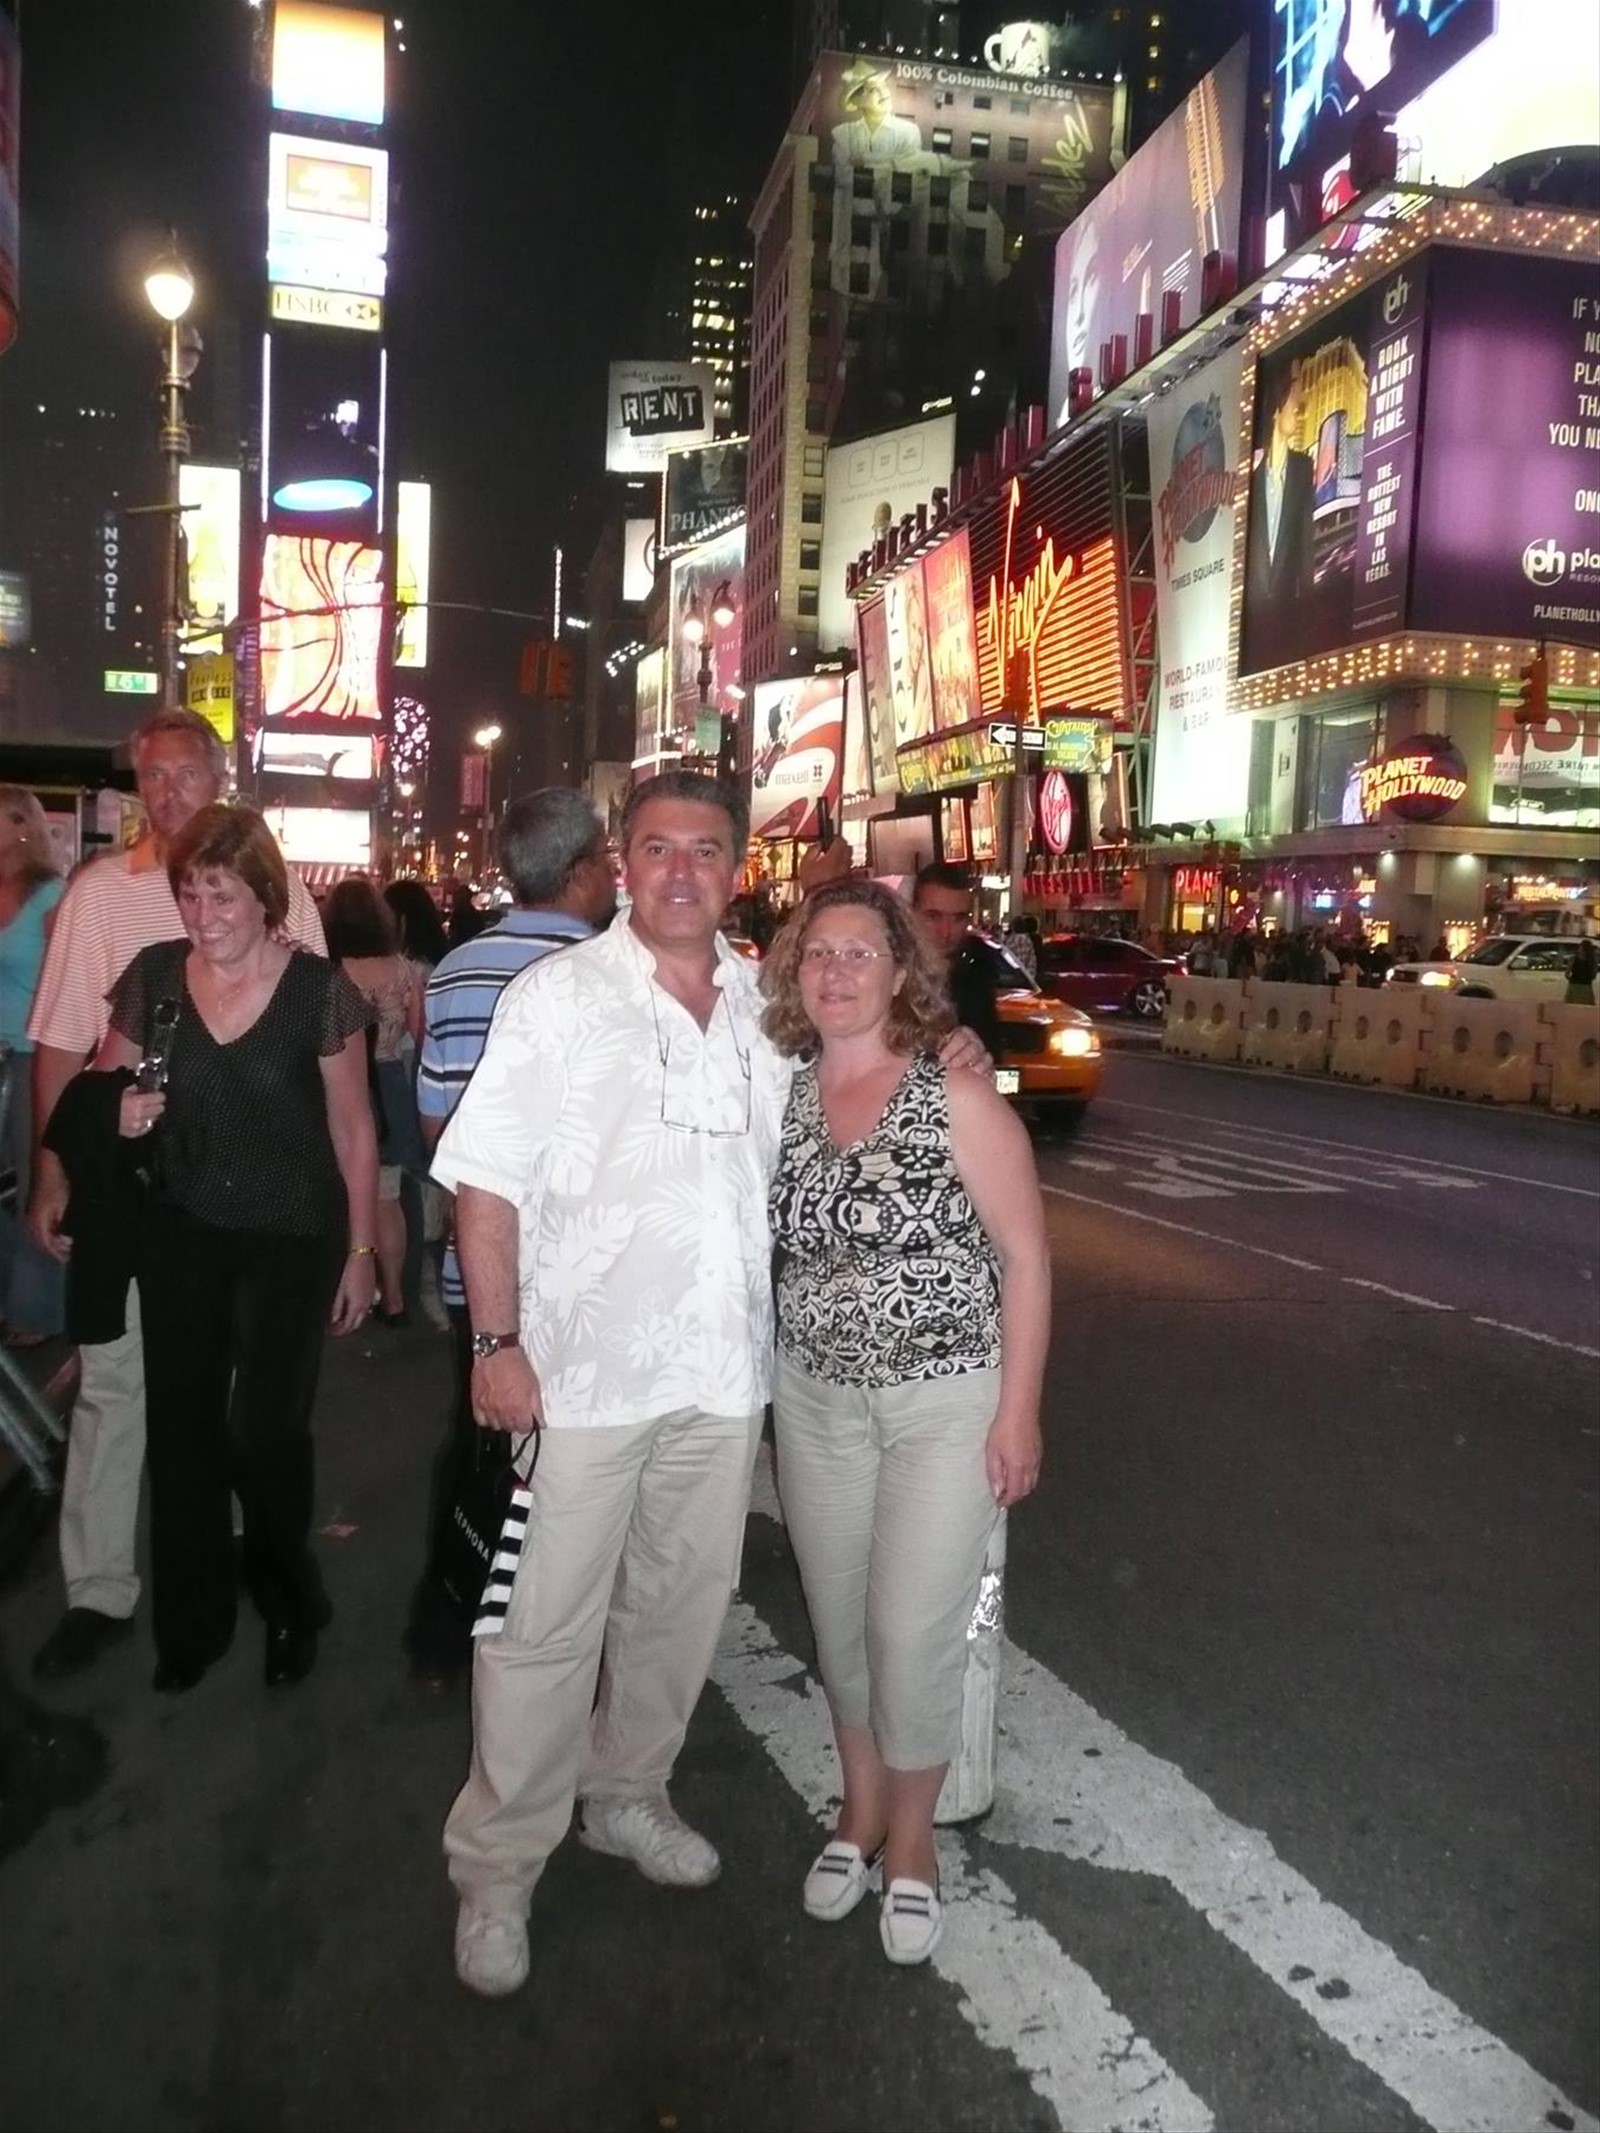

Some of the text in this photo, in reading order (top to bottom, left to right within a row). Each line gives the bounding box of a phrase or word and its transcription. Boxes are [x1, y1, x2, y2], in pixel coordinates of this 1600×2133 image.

[896, 64, 1073, 100] 100% Colombian Coffee
[276, 291, 332, 314] HSBC
[1573, 298, 1588, 319] IF
[1378, 335, 1409, 370] BOOK
[1370, 353, 1415, 397] A NIGHT
[623, 391, 698, 422] RENT
[1376, 384, 1404, 416] WITH
[1372, 406, 1406, 440] FAME.
[1549, 423, 1580, 447] YOU
[1377, 462, 1393, 482] THE
[1367, 474, 1402, 503] HOTTEST
[1373, 495, 1393, 517] NEW
[1366, 510, 1398, 535] RESORT
[1375, 531, 1386, 548] IN
[1372, 547, 1387, 566] LAS
[1523, 538, 1566, 587] ph
[104, 526, 119, 631] NOVOTEL
[1171, 558, 1225, 592] TIMES SQUARE
[775, 770, 809, 785] maxell
[1361, 757, 1433, 798] PLANET
[1363, 774, 1467, 818] HOLLYWOOD
[453, 1504, 490, 1562] SEPHORA
